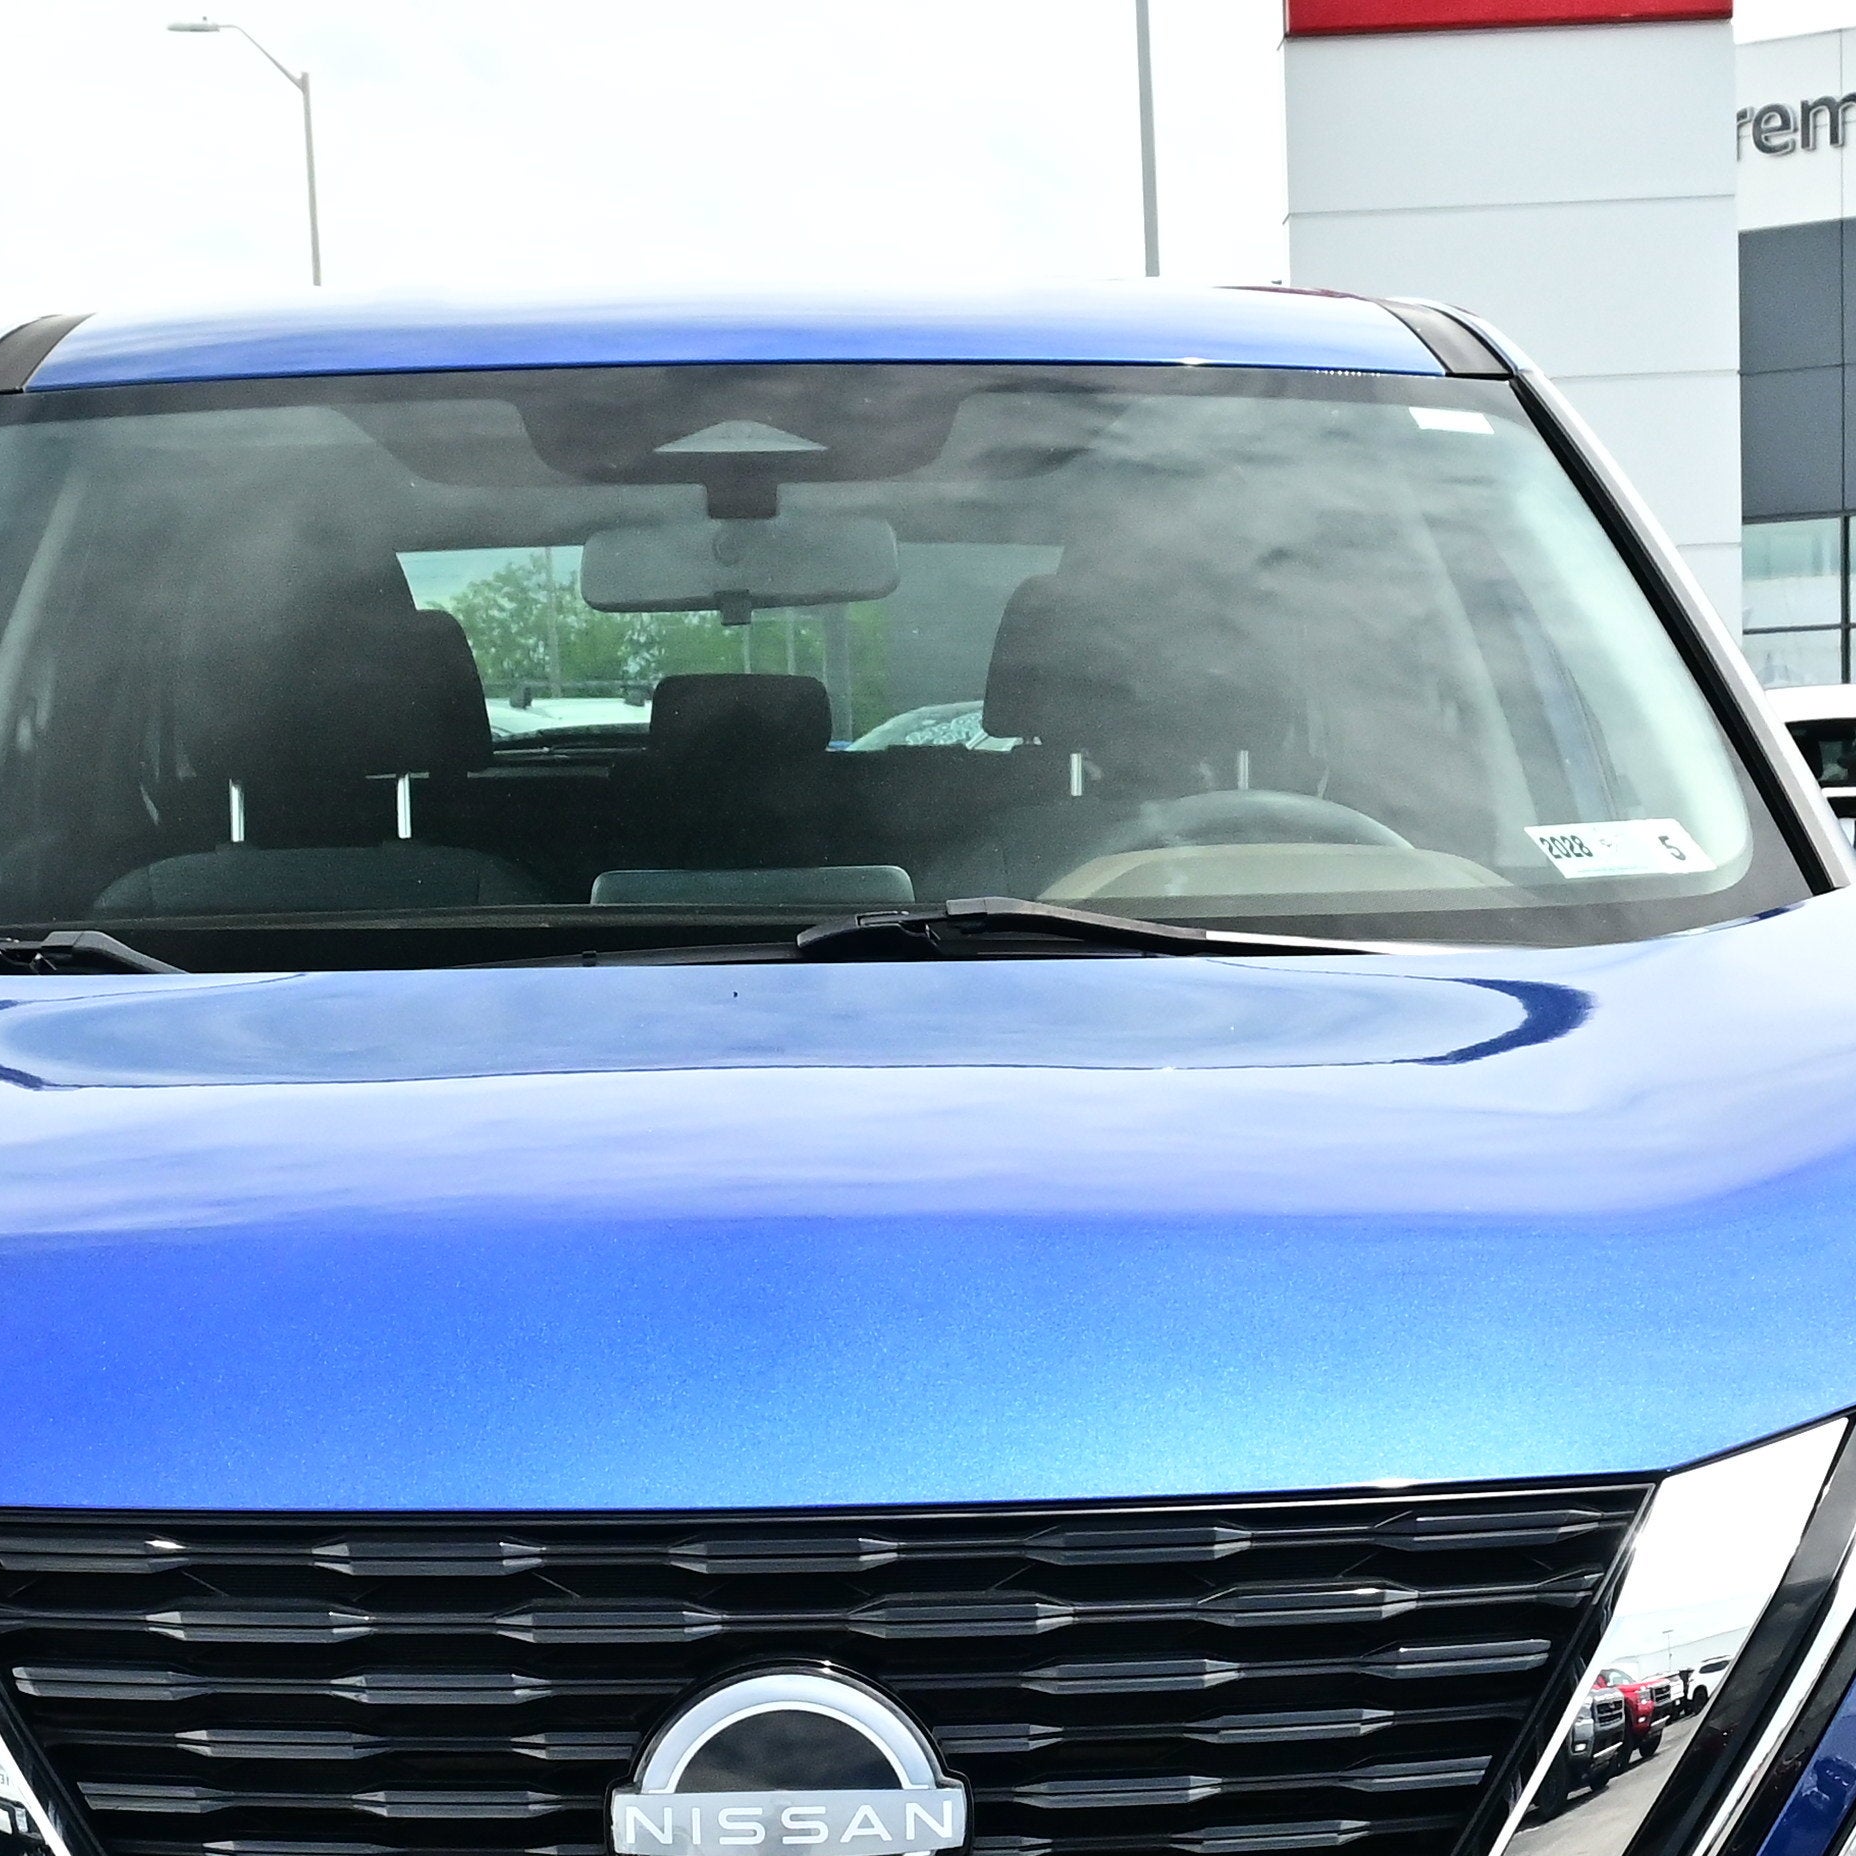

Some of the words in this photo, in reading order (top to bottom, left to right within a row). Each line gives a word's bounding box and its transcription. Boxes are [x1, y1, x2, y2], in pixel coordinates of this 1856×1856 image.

[1539, 835, 1593, 858] 2028
[1658, 835, 1686, 861] 5
[624, 1800, 952, 1846] NISSAN
